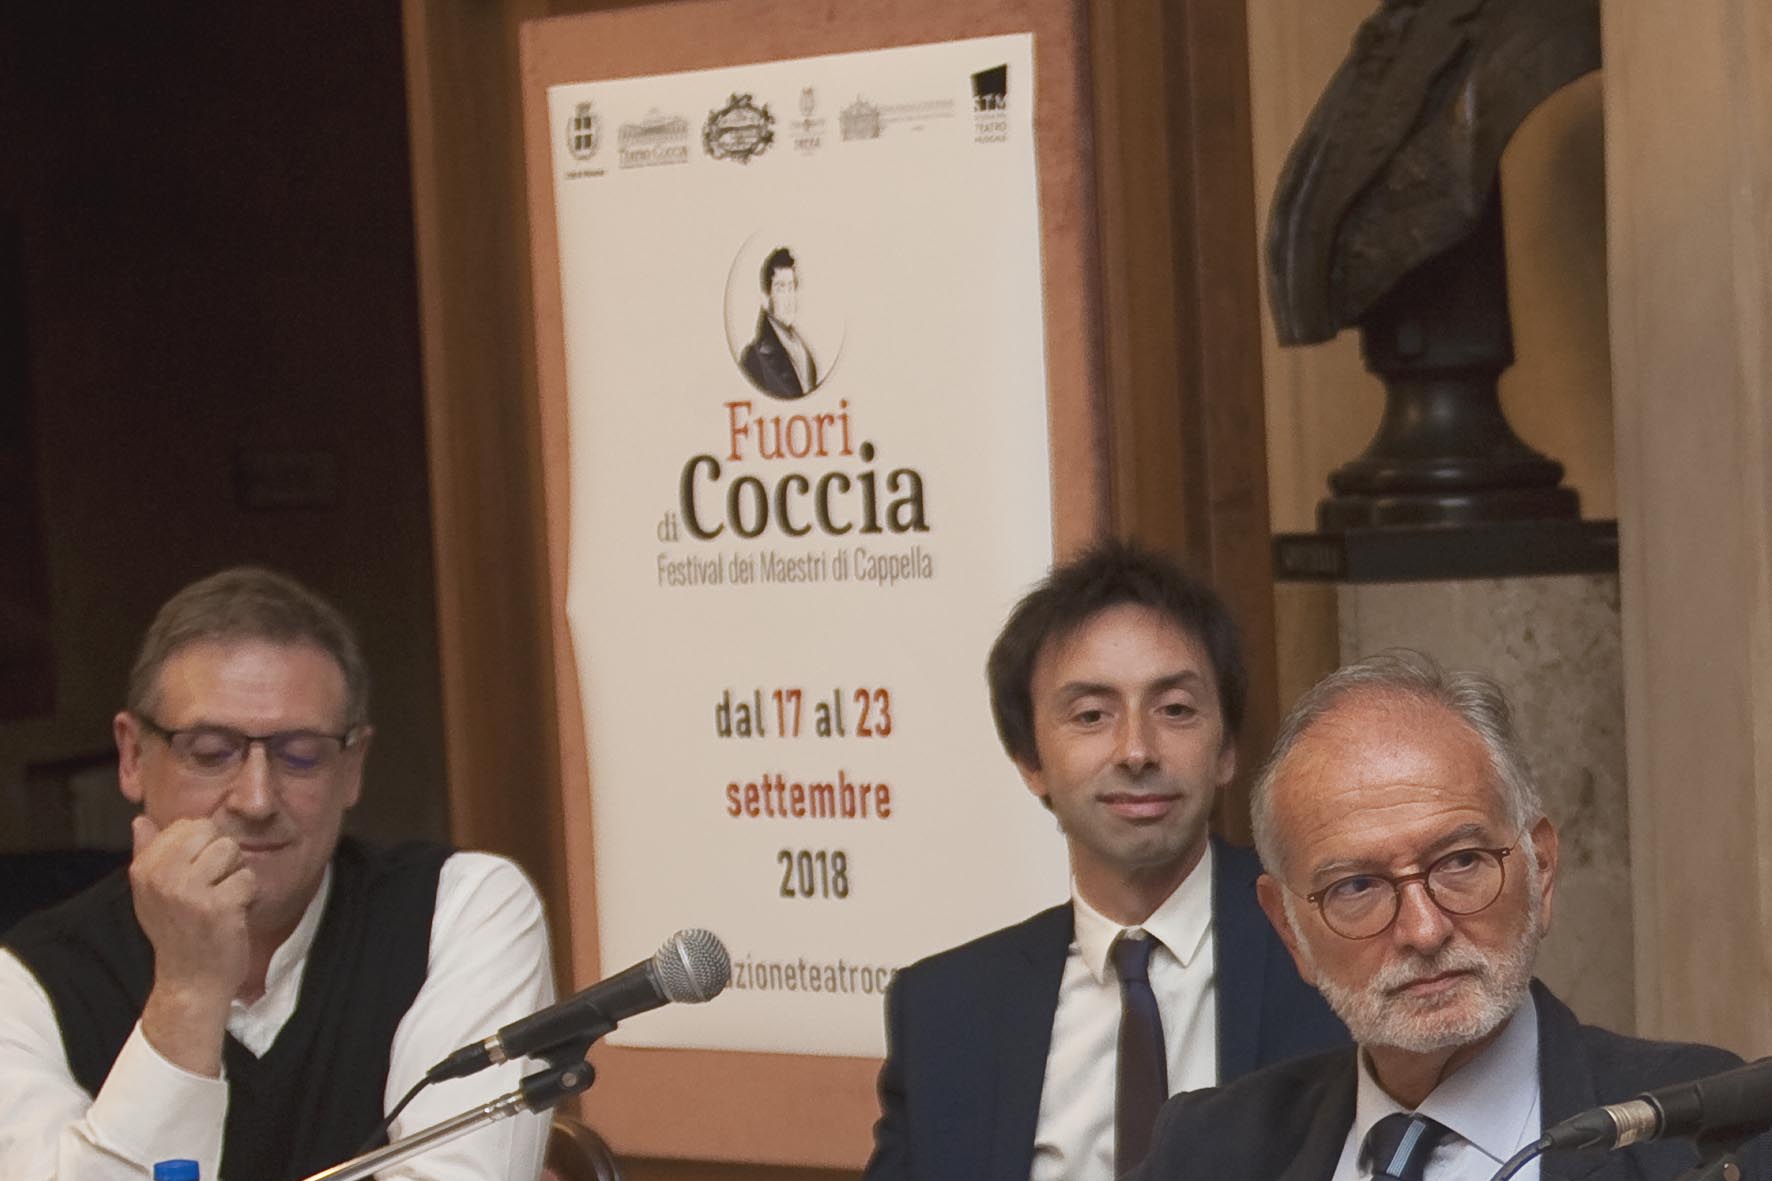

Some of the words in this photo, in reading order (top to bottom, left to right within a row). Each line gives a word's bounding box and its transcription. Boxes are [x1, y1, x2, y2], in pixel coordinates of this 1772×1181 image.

[724, 398, 853, 462] Fuori
[656, 511, 679, 543] di
[679, 440, 930, 540] Coccia
[656, 551, 723, 587] Festival
[729, 551, 755, 584] dei
[760, 549, 827, 583] Maestri
[832, 548, 849, 582] di
[854, 545, 933, 587] Cappella
[715, 687, 765, 738] dal
[772, 687, 802, 737] 17
[815, 687, 845, 737] al
[853, 687, 892, 737] 23
[725, 769, 892, 820] settembre
[777, 849, 850, 899] 2018
[726, 953, 898, 994] zioneteatroc
